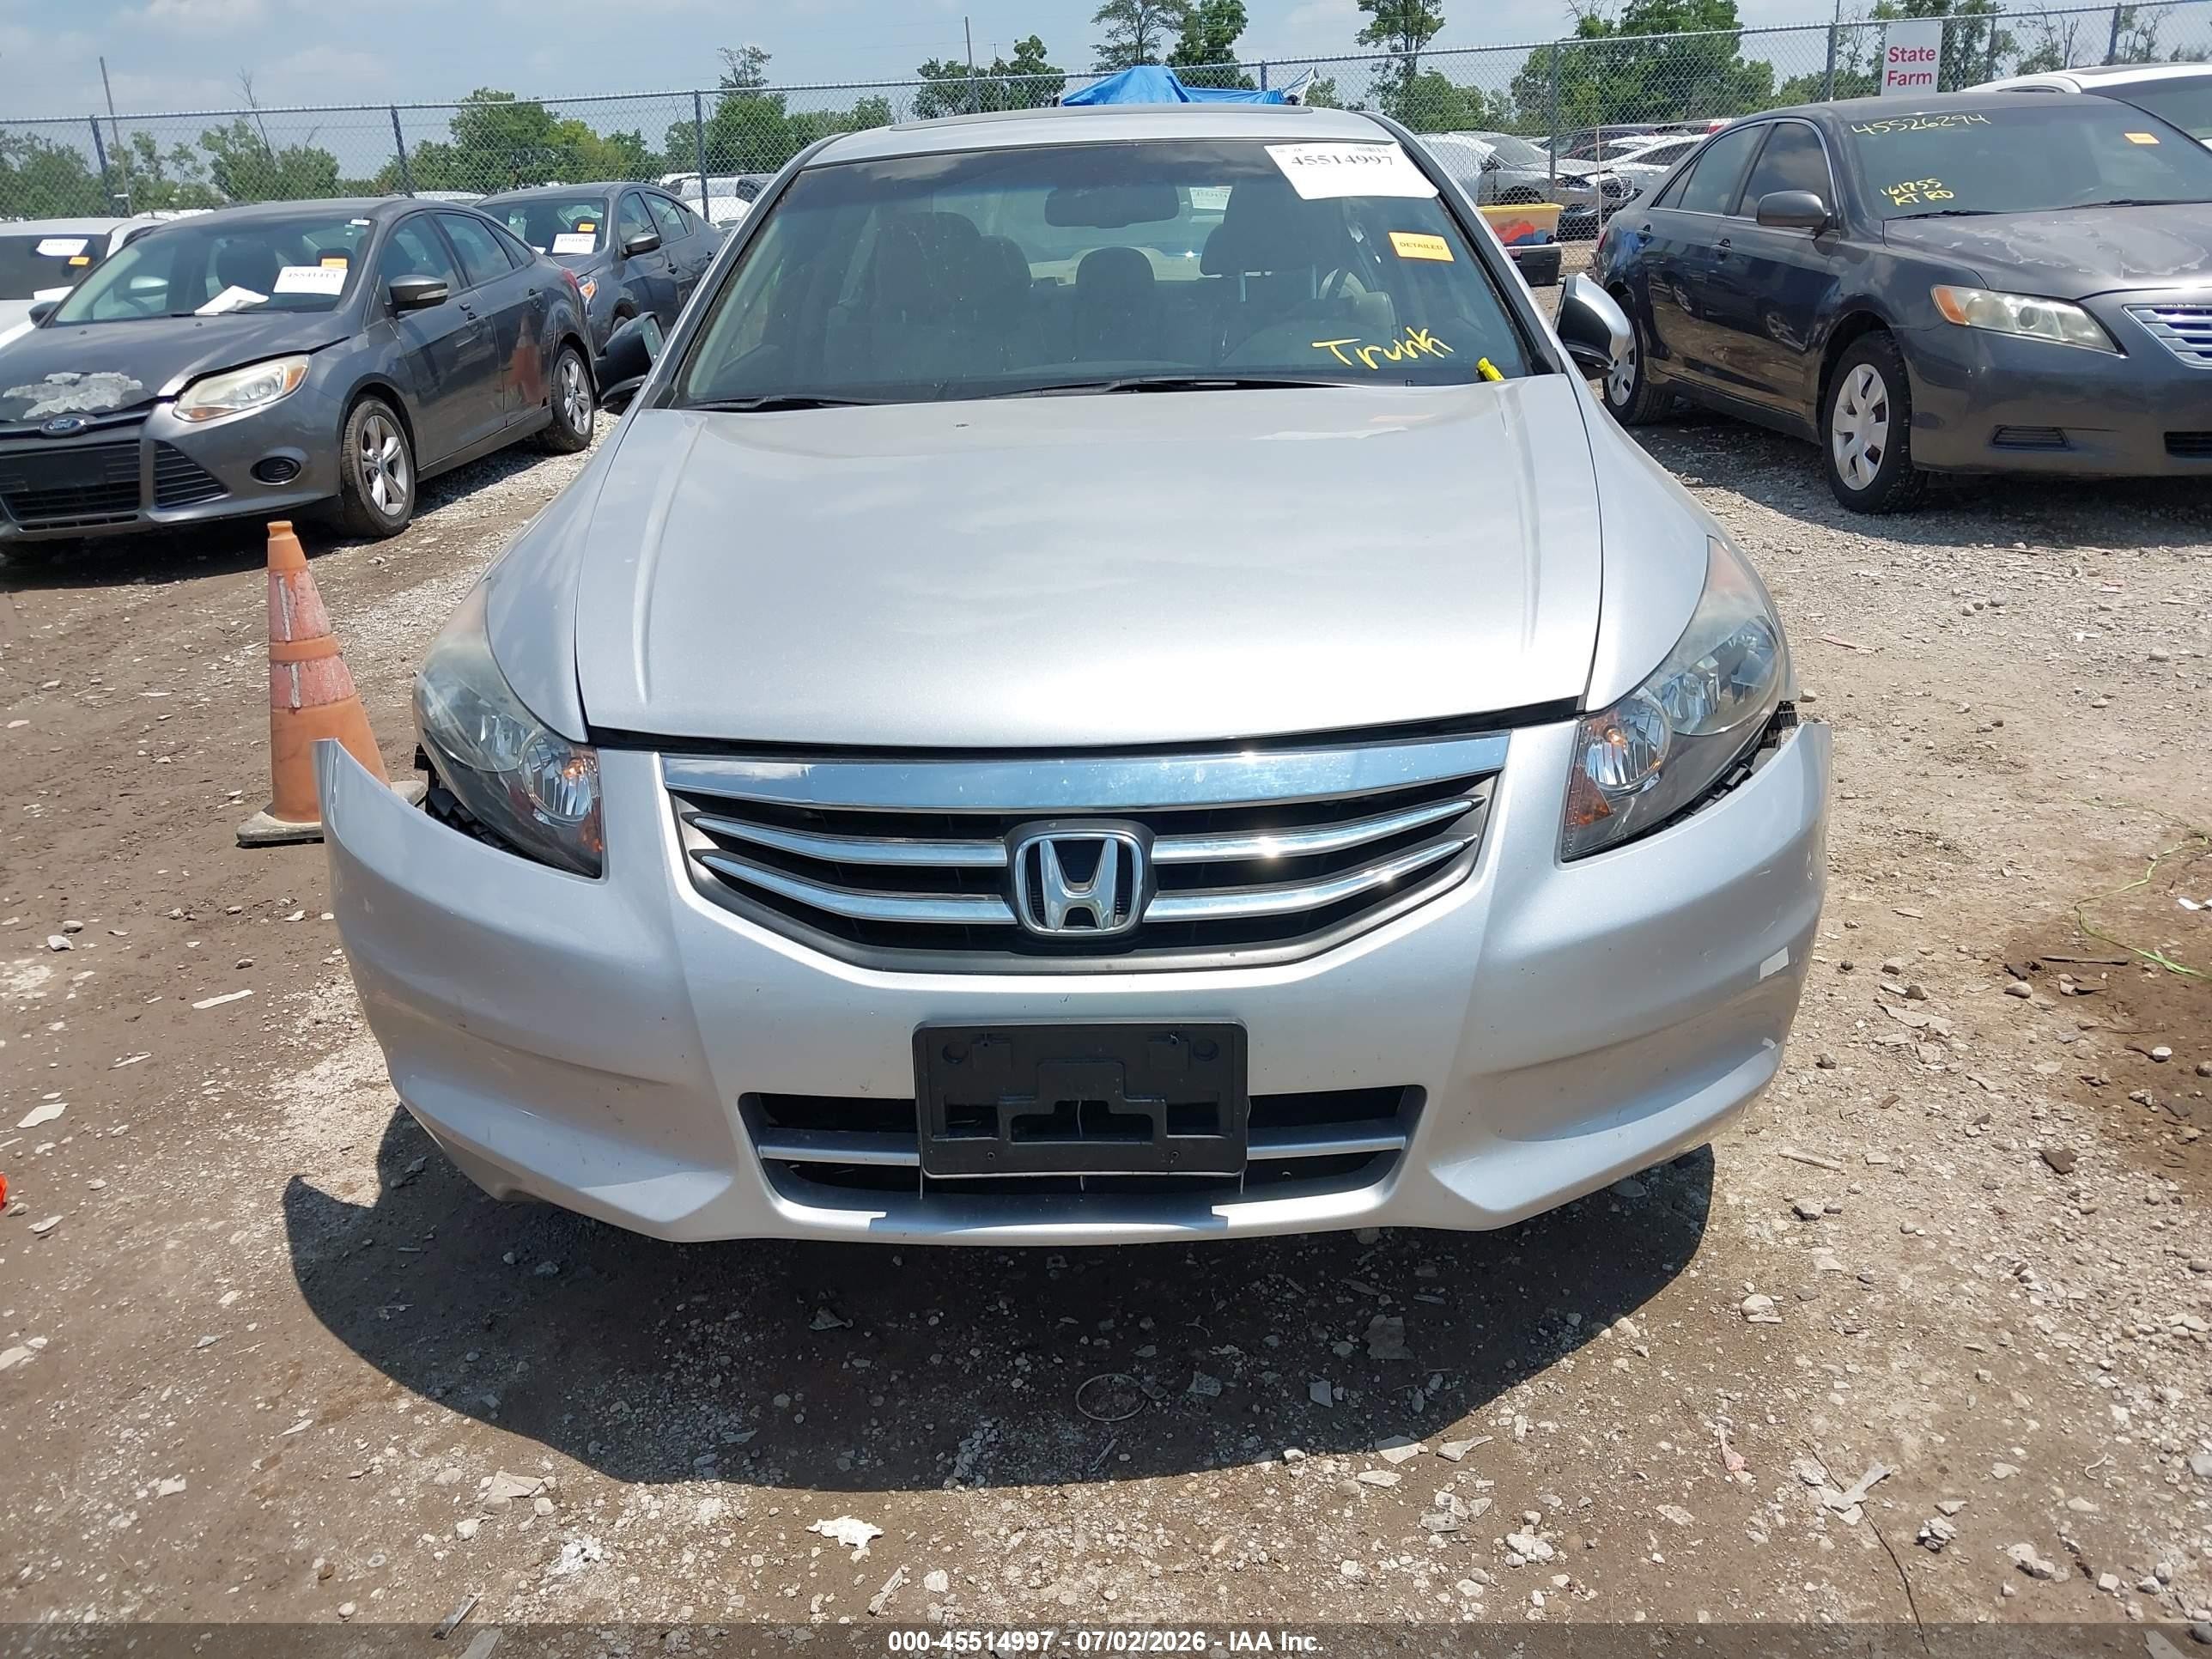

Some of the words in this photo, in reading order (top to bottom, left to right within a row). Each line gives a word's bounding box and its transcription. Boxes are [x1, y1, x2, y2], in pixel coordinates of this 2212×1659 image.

[1888, 46, 1936, 63] State
[1887, 70, 1932, 87] Farm
[1851, 113, 1991, 135] 45526294
[1291, 155, 1393, 166] 45514997
[1400, 241, 1443, 250] DETAILED
[1311, 326, 1455, 369] Trunk
